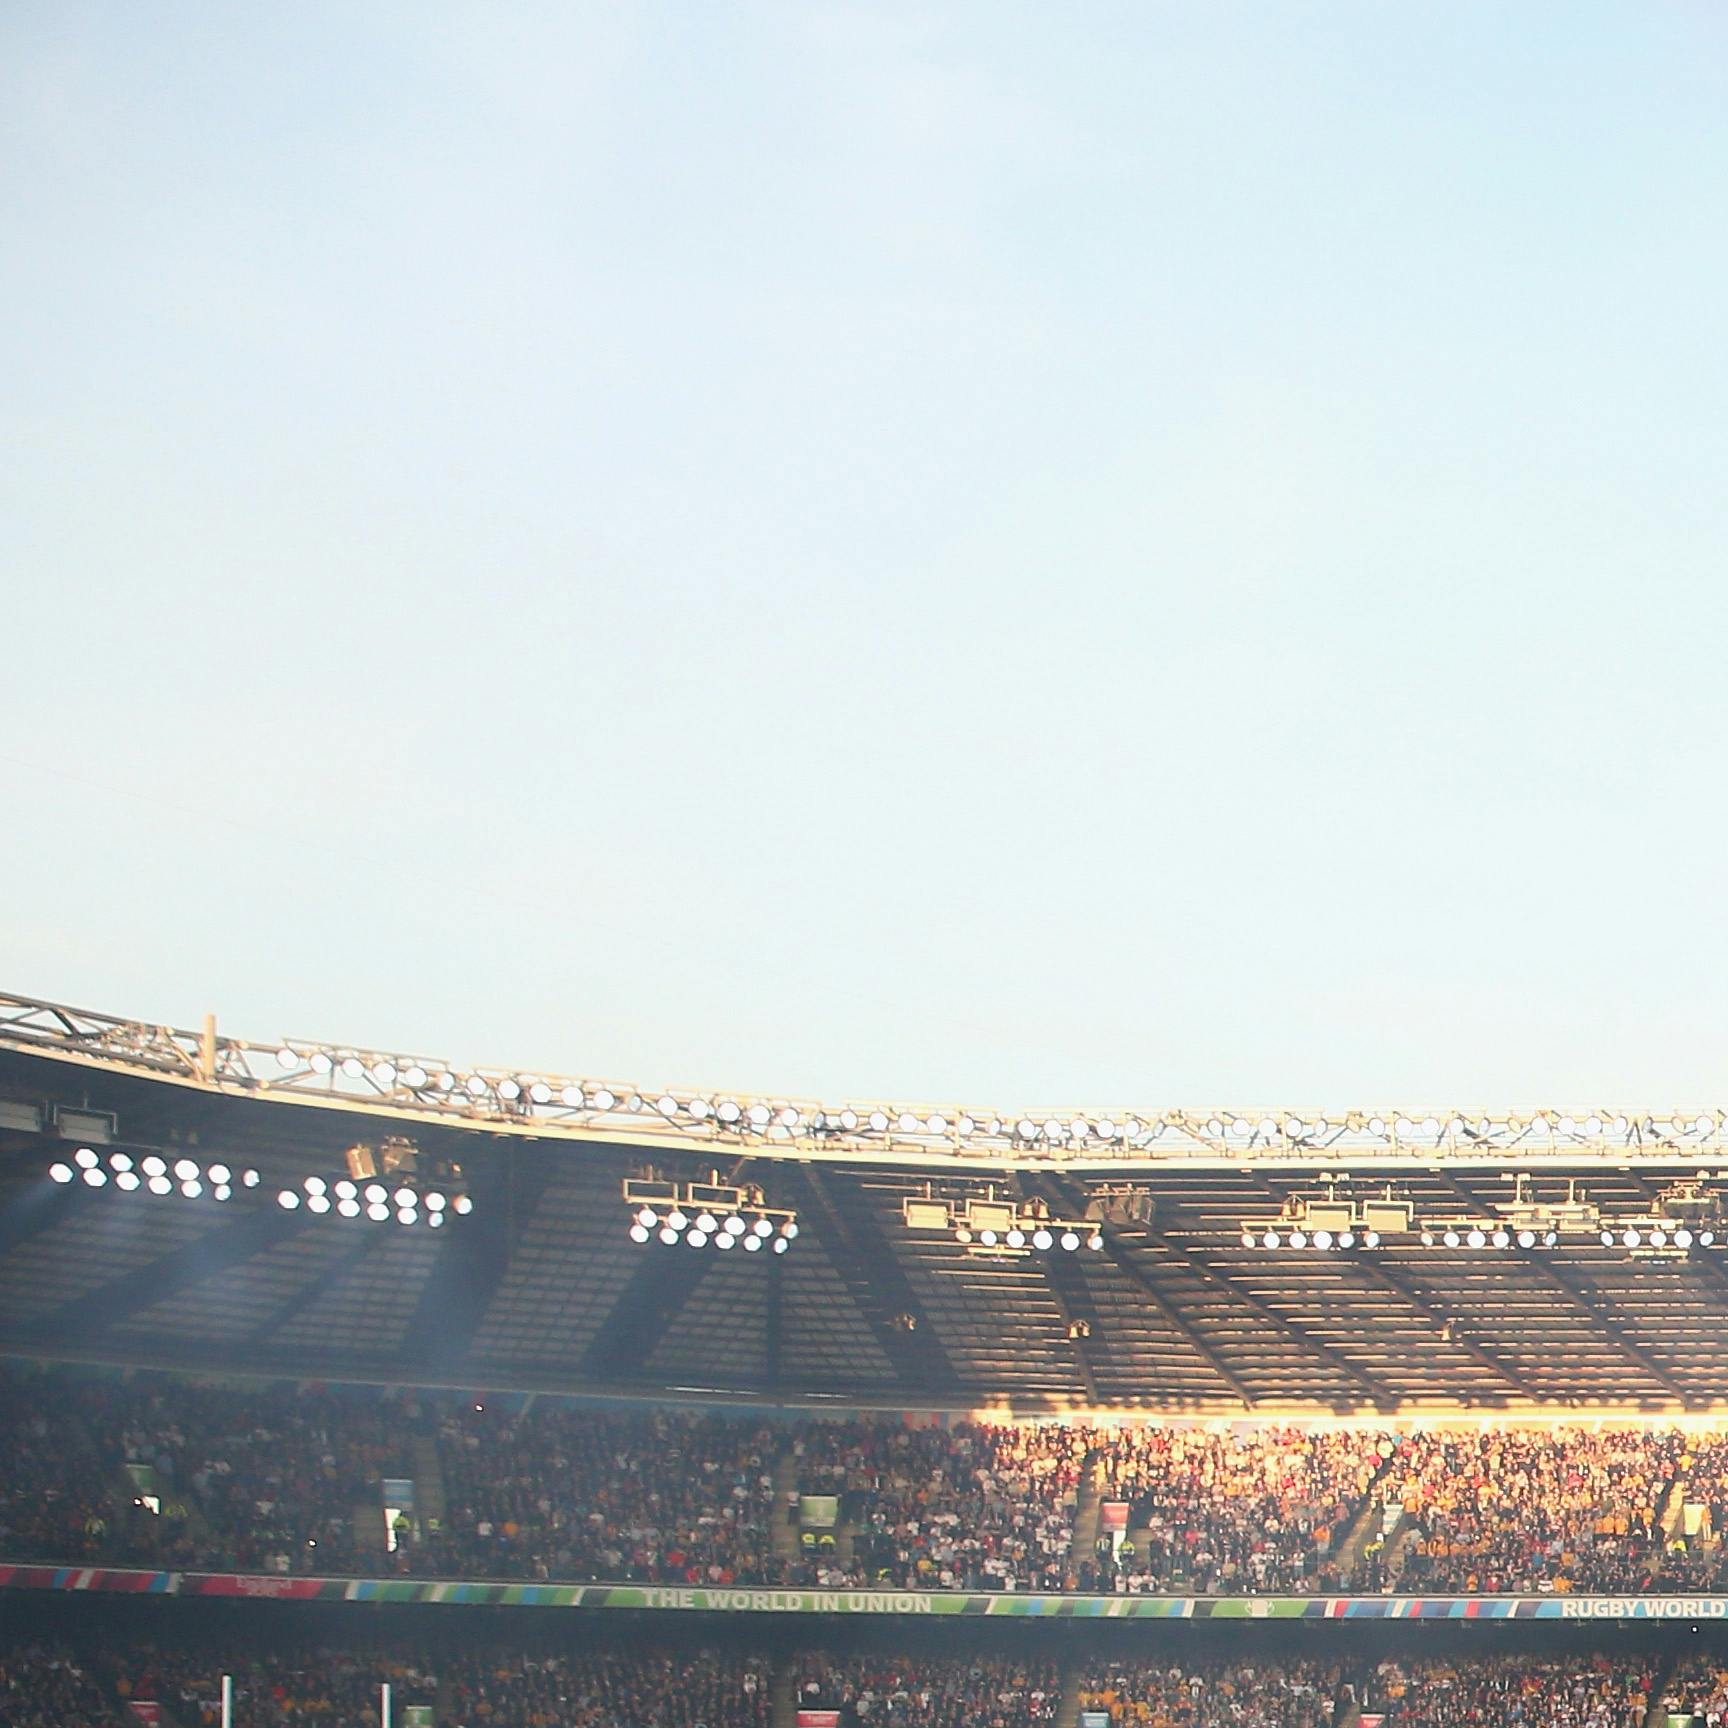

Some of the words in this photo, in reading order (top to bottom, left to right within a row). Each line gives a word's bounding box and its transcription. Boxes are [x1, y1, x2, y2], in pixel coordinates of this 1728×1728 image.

[642, 1588, 695, 1608] THE
[705, 1591, 802, 1610] WORLD
[812, 1593, 838, 1611] IN
[849, 1594, 932, 1613] UNION
[1561, 1601, 1645, 1618] RUGBY
[1645, 1601, 1726, 1618] WORLD
